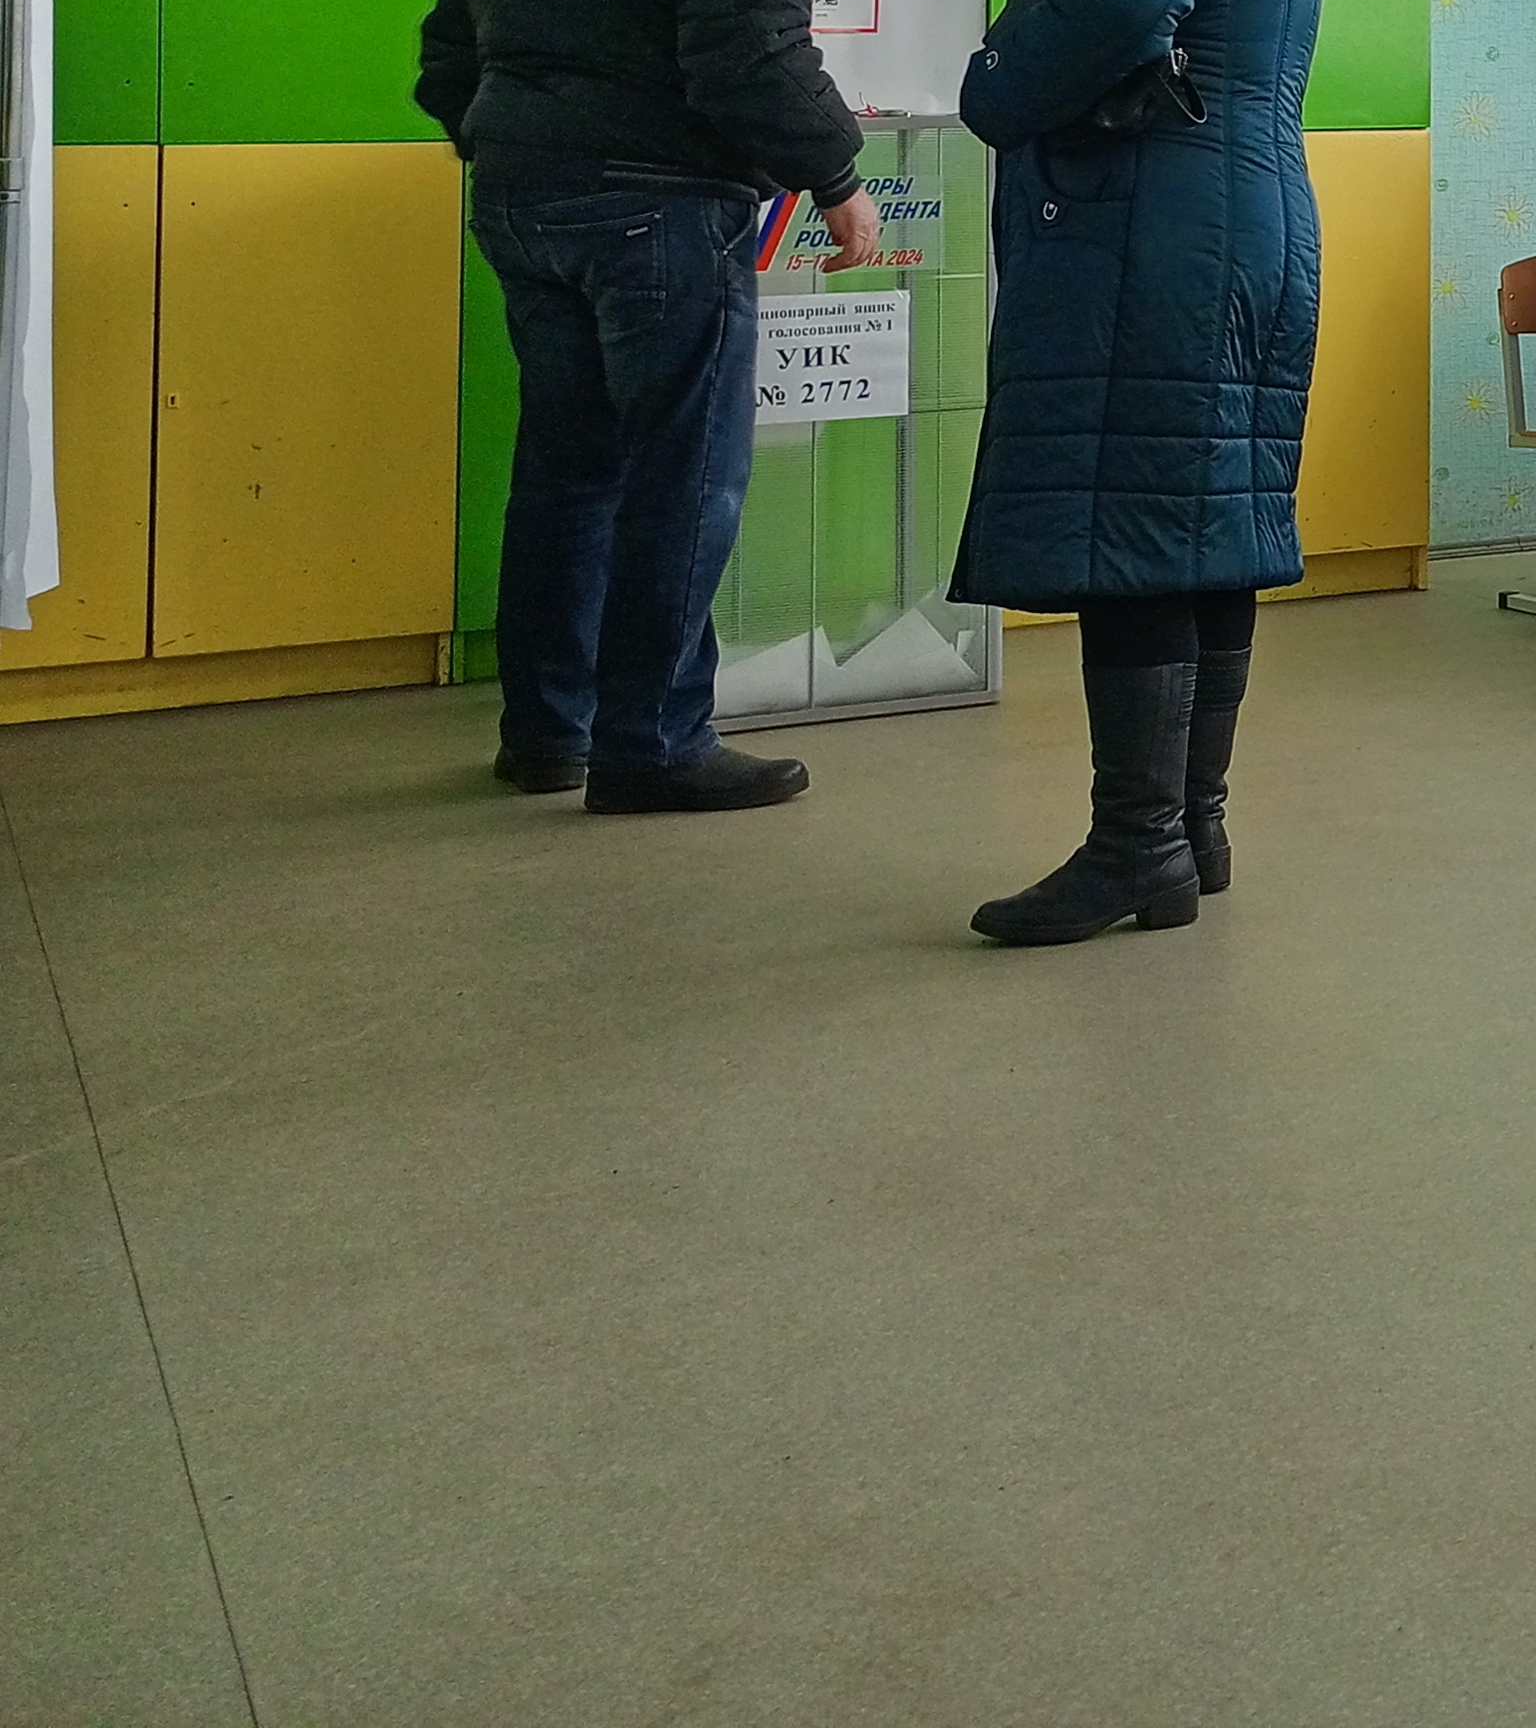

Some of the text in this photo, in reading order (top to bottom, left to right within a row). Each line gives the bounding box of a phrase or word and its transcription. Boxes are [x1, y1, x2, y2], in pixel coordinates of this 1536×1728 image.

[886, 249, 924, 266] 2024
[760, 303, 896, 321] ционарный ящик
[768, 319, 893, 339] голосования № 1
[775, 344, 851, 370] УИК
[756, 378, 871, 407] № 2772
